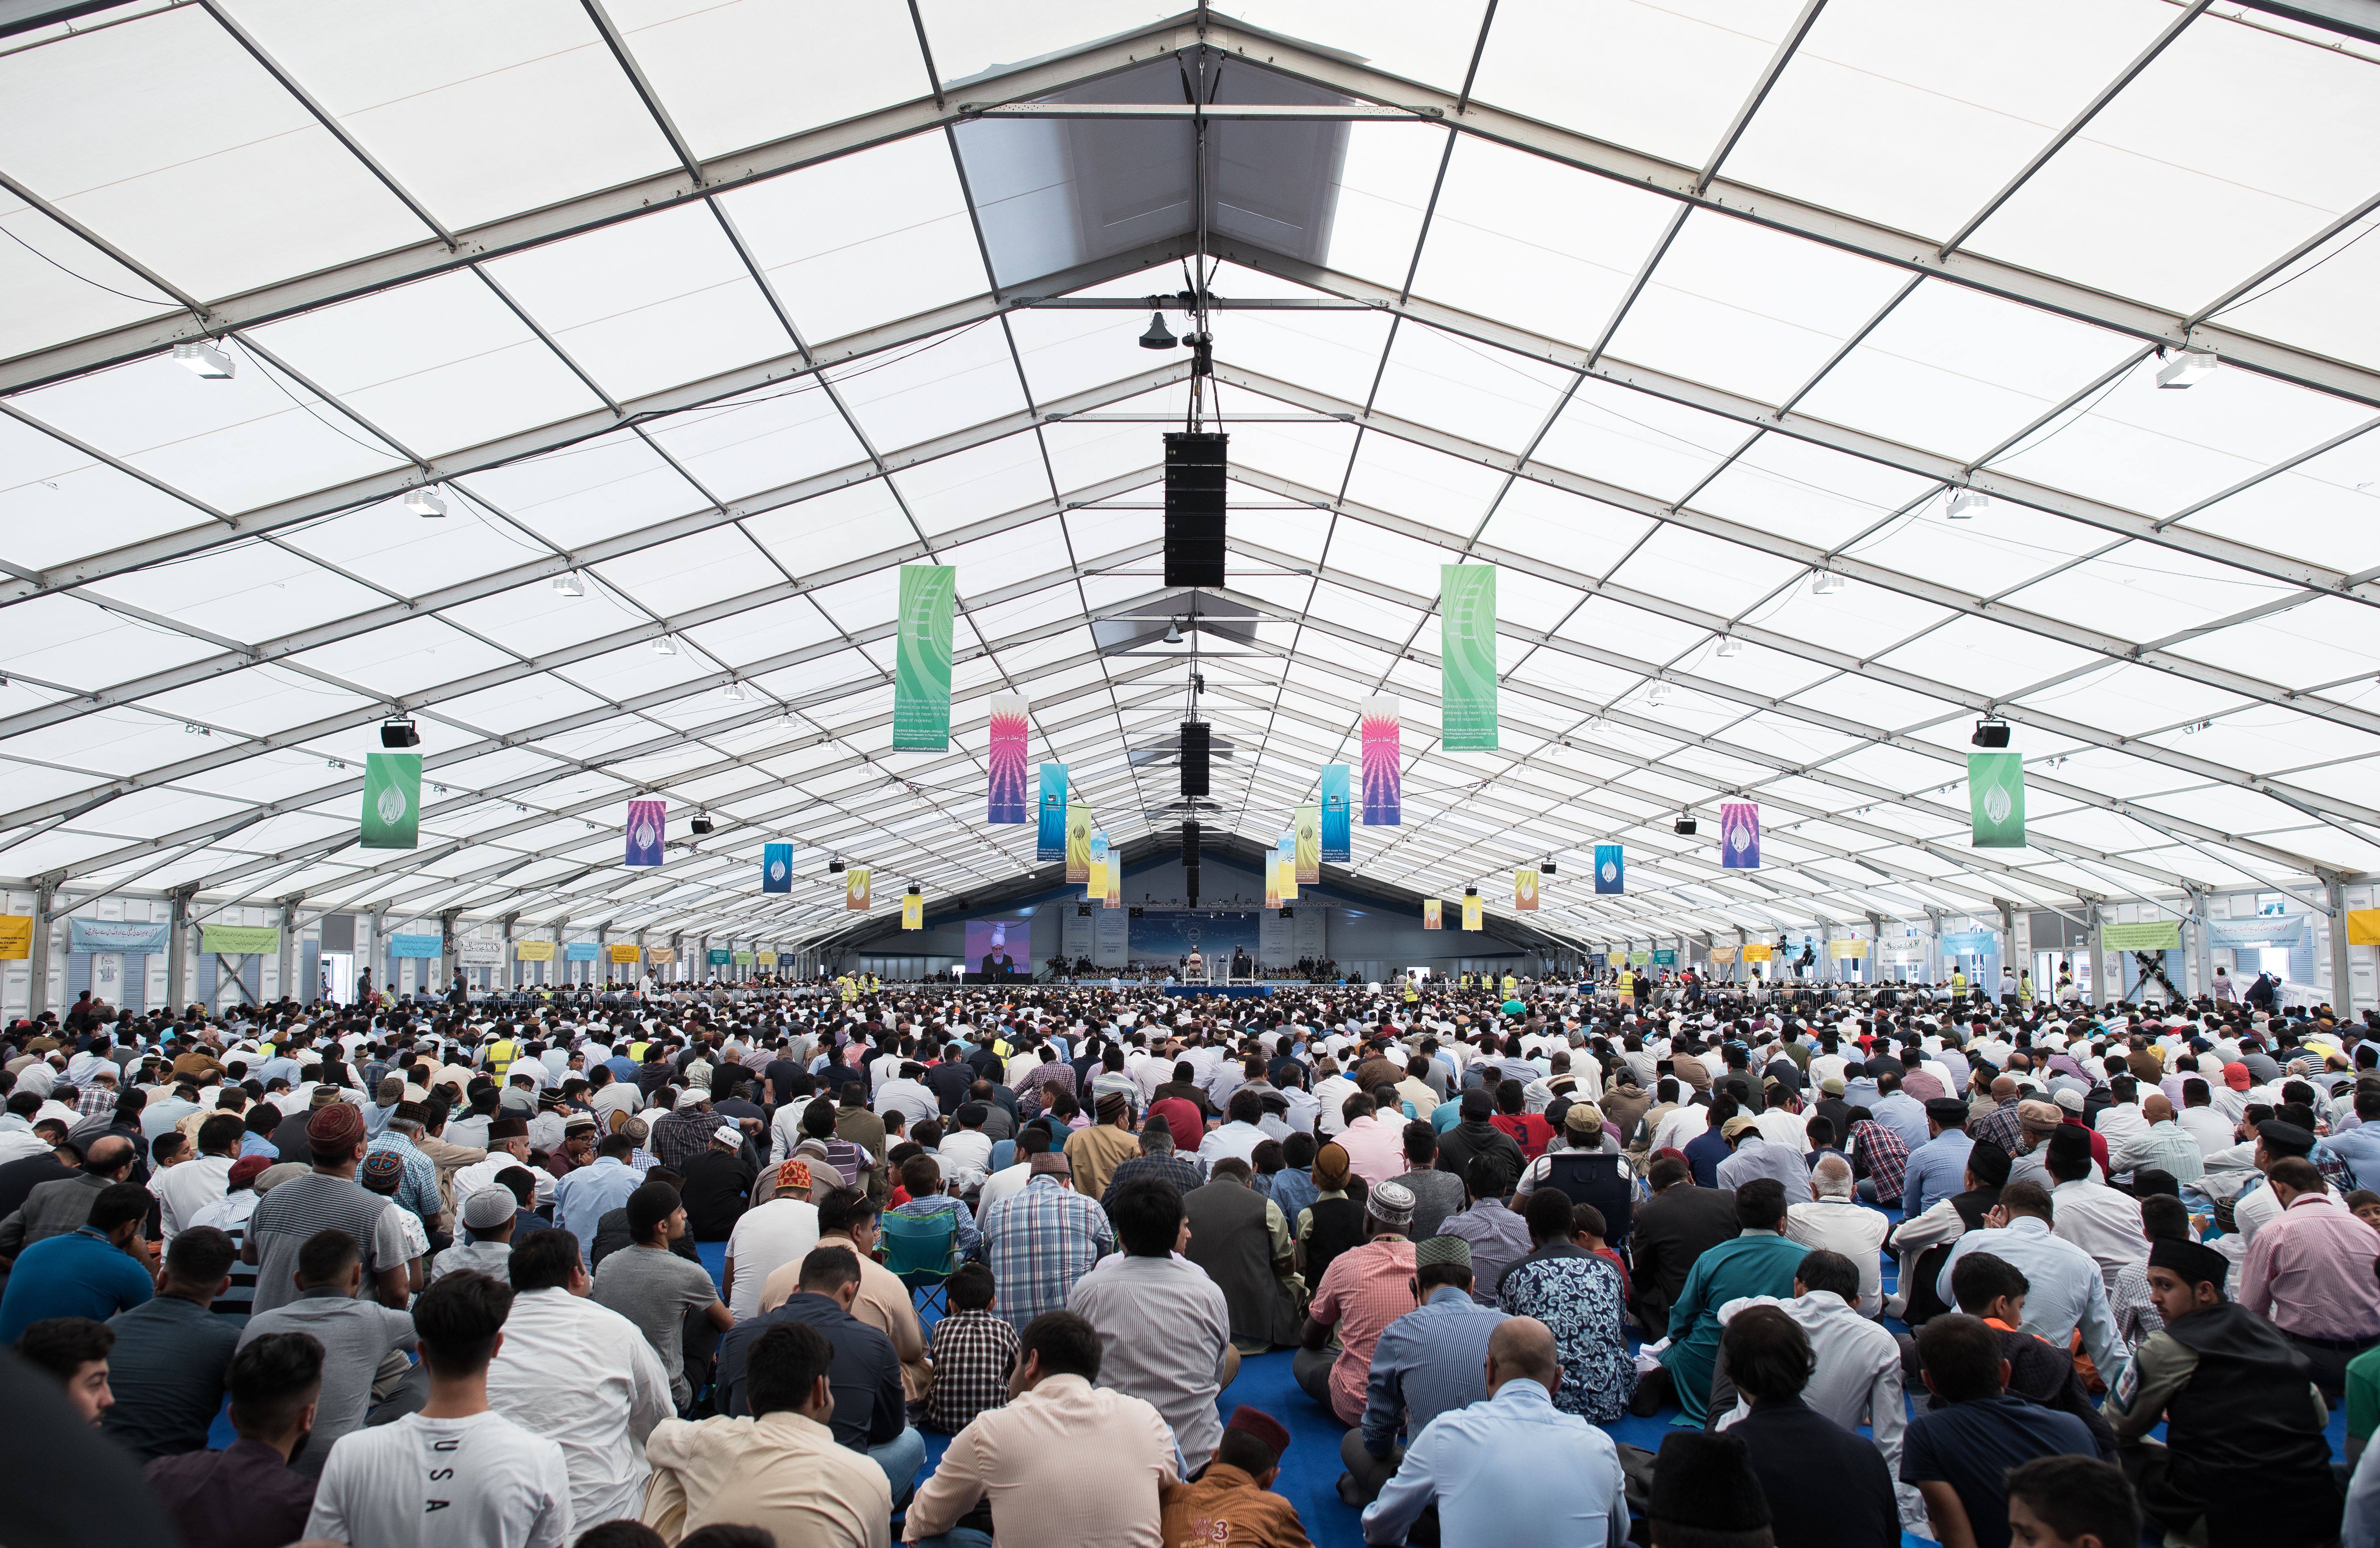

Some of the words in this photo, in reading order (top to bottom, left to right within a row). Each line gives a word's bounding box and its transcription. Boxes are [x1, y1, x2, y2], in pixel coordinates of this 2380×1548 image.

[1514, 1125, 1528, 1145] 3
[426, 1439, 460, 1513] USA
[1212, 1519, 1229, 1542] 3
